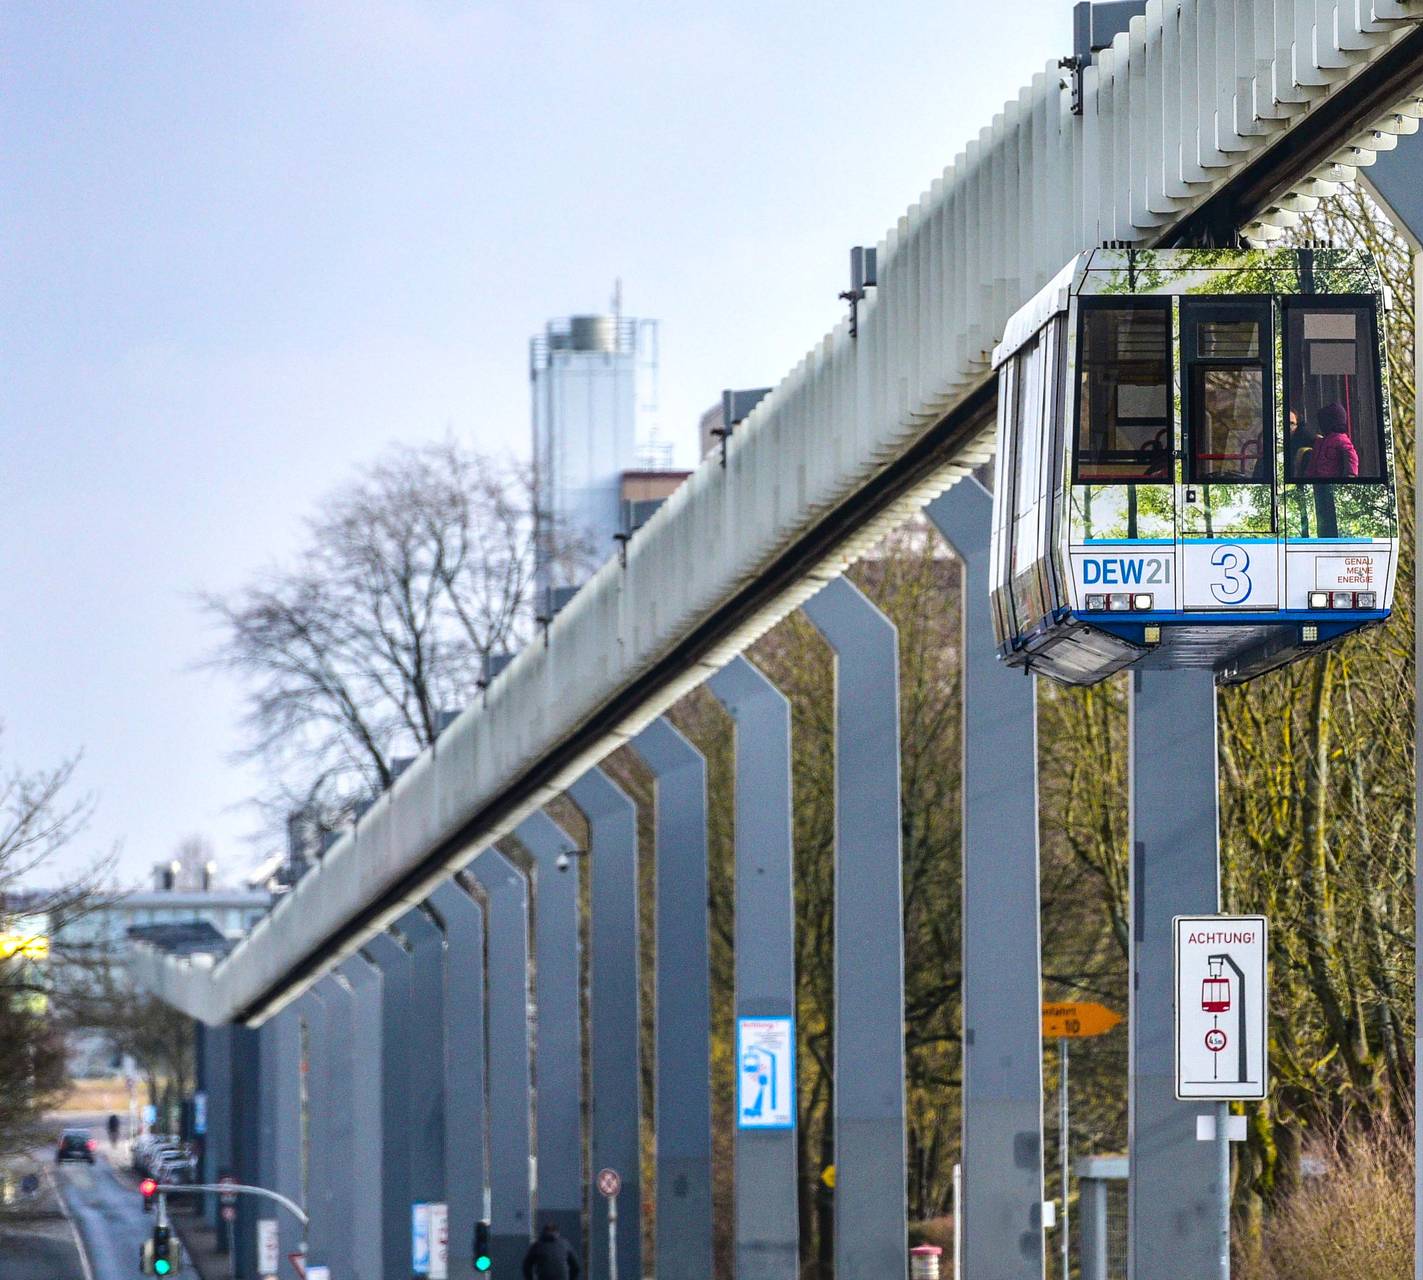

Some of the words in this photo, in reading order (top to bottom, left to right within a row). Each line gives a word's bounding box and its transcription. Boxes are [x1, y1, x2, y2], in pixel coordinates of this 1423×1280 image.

[1344, 558, 1374, 566] GENAU
[1210, 544, 1252, 605] 3
[1346, 566, 1373, 575] MEINE
[1337, 575, 1373, 584] ENERGIE
[1188, 932, 1255, 944] ACHTUNG!
